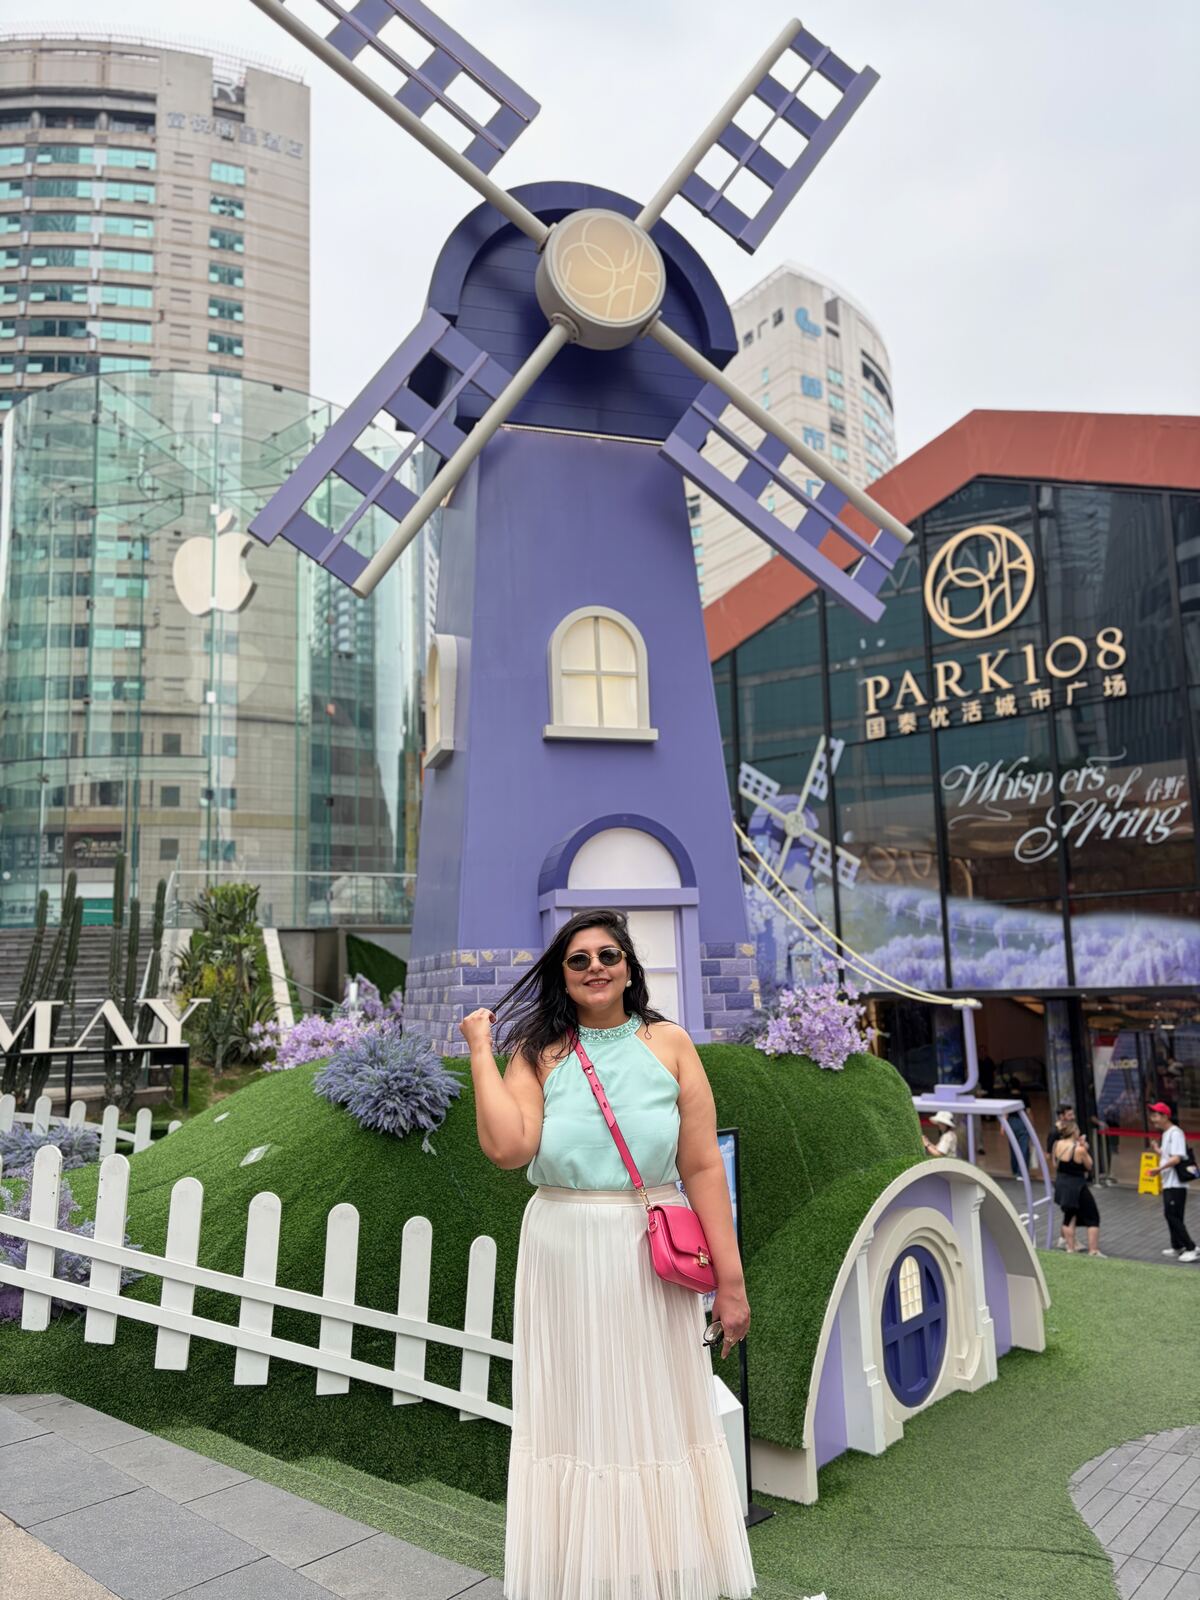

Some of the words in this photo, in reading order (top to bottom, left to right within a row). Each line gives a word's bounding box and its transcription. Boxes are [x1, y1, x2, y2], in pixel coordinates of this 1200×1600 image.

[863, 626, 1127, 715] PARK108
[865, 673, 1128, 740] 国泰优活城市广场
[941, 752, 1116, 815] Whispers
[1106, 767, 1142, 809] of
[1014, 799, 1190, 863] Spring
